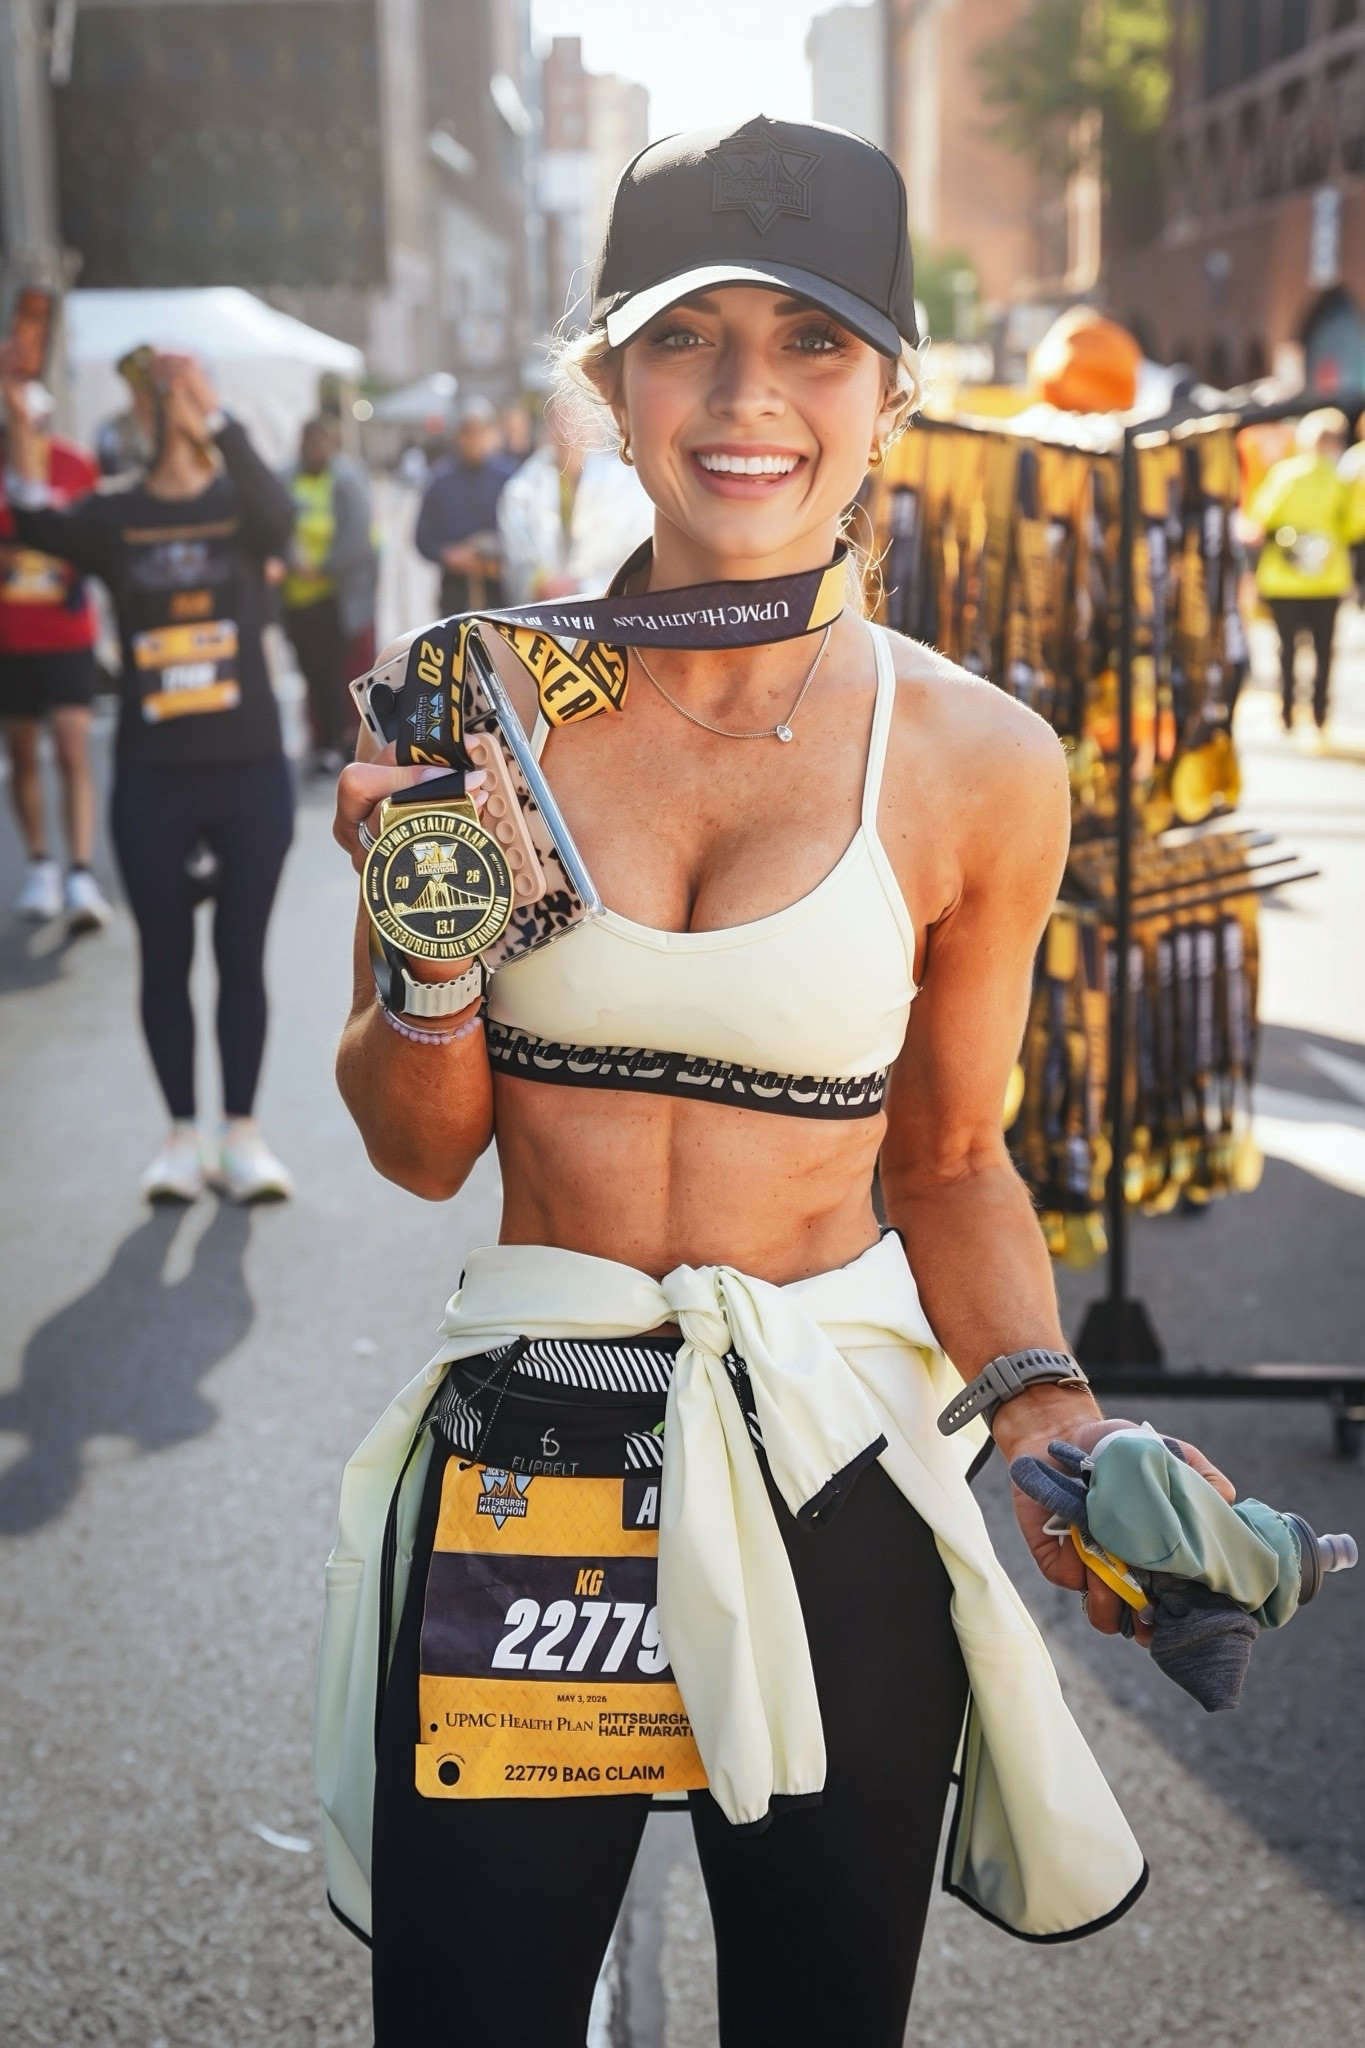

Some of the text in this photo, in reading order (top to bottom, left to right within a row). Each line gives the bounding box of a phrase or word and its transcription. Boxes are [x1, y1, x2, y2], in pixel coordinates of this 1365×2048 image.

[552, 615, 595, 630] HALF
[613, 601, 789, 630] UPMC HEALTH PLAN
[417, 640, 445, 687] 20
[376, 817, 489, 858] UPMC HEALTH PLAN
[395, 876, 410, 890] 20
[466, 870, 480, 884] 26
[375, 896, 508, 958] PITTSBURGH HALF MARATHON
[435, 919, 455, 935] 13.1
[486, 1467, 505, 1476] DICK'S
[511, 1456, 579, 1476] FLIPBELT
[478, 1505, 526, 1516] MARATHON
[479, 1496, 526, 1508] PITTSBURGH
[635, 1486, 658, 1525] A
[574, 1569, 605, 1596] KG
[491, 1598, 671, 1675] 22779
[557, 1695, 607, 1704] MAY 3, 2026
[445, 1712, 593, 1732] UPMC HEALTH PLAN
[599, 1713, 690, 1725] PITTSBURGH
[599, 1726, 635, 1737] HALF
[504, 1765, 665, 1783] 22779 BAG CLAIM
